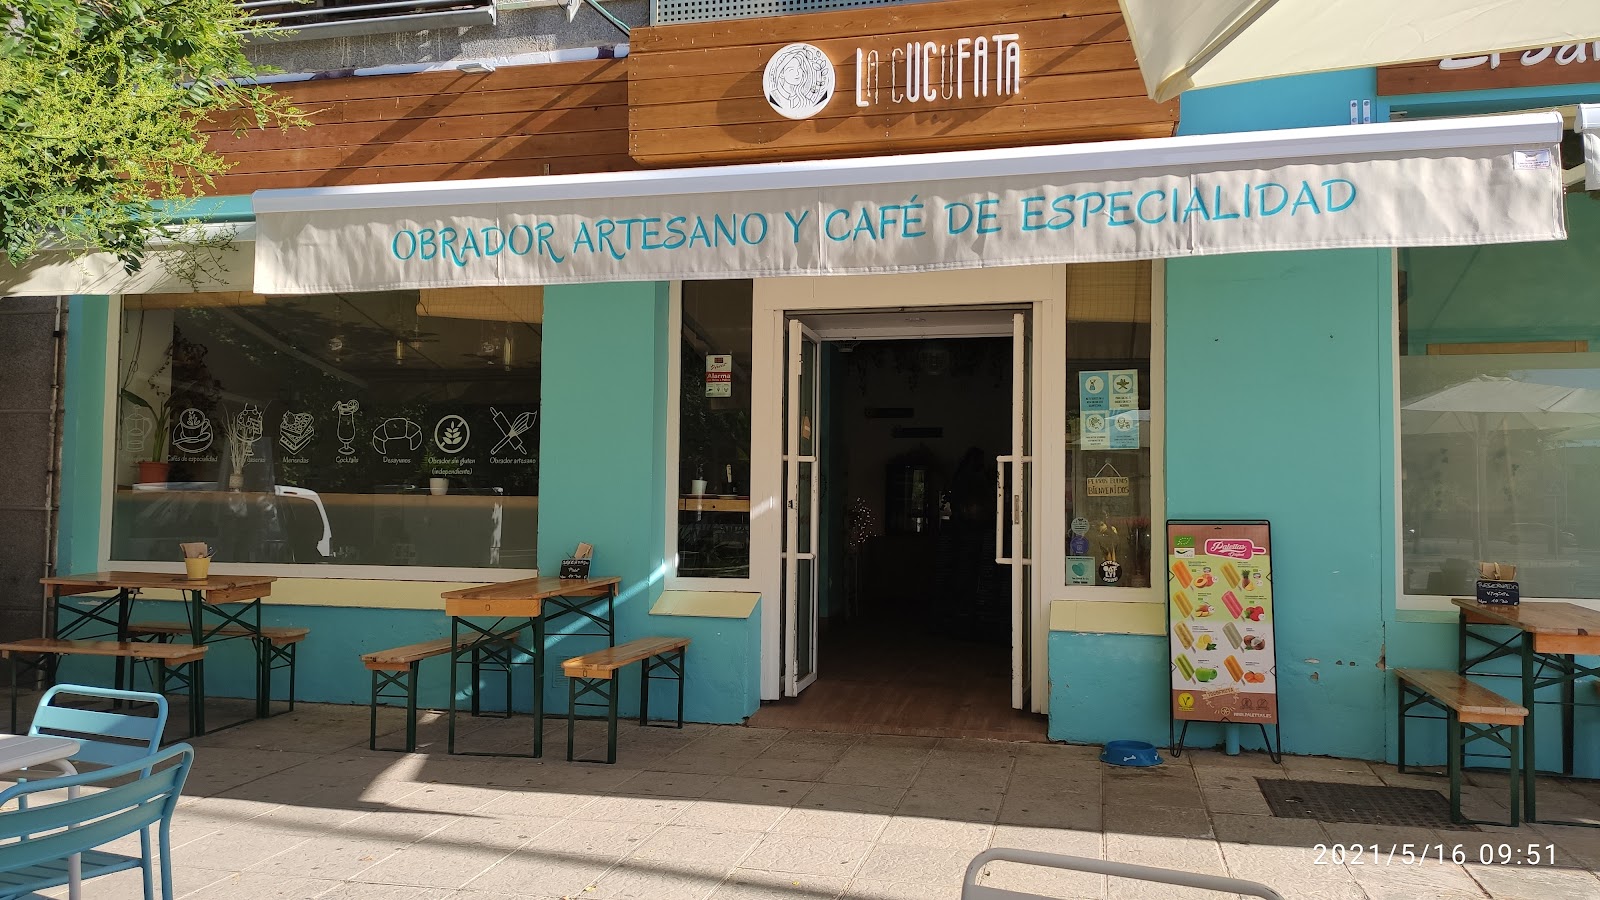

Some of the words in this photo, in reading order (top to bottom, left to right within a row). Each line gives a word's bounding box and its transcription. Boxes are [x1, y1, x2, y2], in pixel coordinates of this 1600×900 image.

[856, 47, 879, 107] LA
[891, 33, 1020, 103] CUCUFATA
[392, 222, 565, 267] OBRADOR
[573, 212, 768, 260] ARTESANO
[784, 210, 811, 244] Y
[825, 195, 926, 242] CAFÉ
[944, 199, 1001, 235] DE
[1021, 178, 1357, 232] ESPECIALIDAD
[188, 455, 218, 463] especialidad
[282, 456, 309, 464] Meriendas
[382, 456, 411, 465] Desayunos
[427, 456, 451, 464] Obrador
[451, 456, 459, 464] sin
[459, 456, 475, 466] gluten
[489, 456, 513, 464] Obrador
[431, 467, 473, 476] (independiente)
